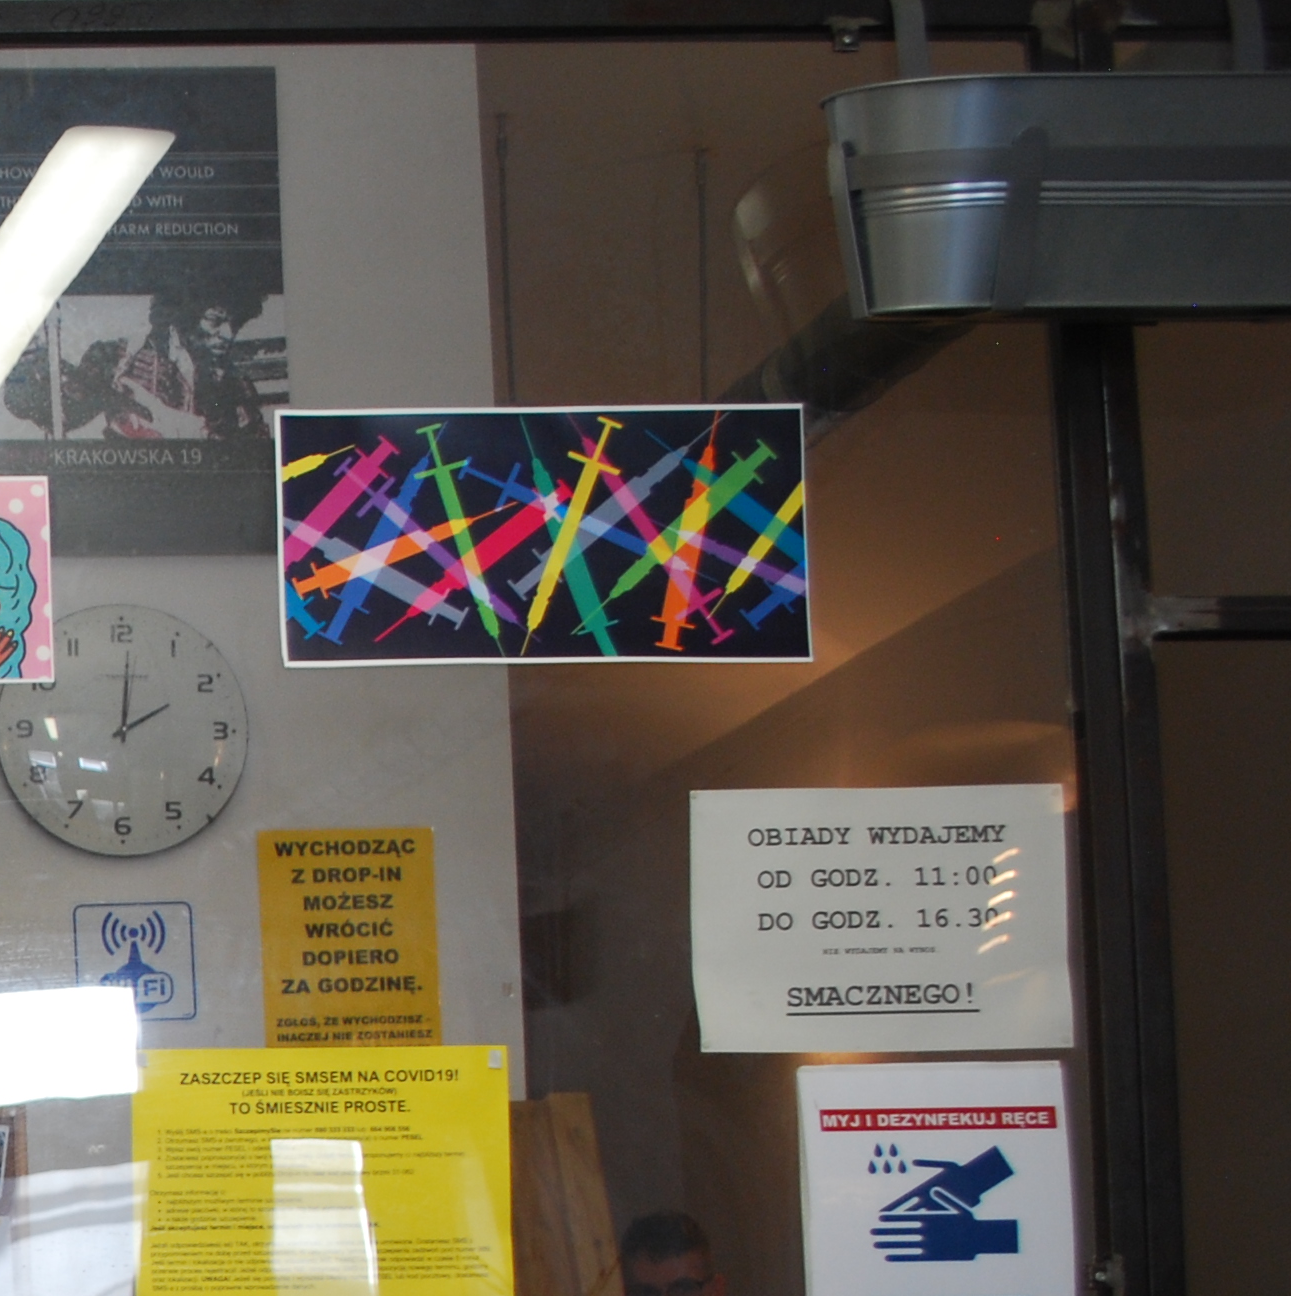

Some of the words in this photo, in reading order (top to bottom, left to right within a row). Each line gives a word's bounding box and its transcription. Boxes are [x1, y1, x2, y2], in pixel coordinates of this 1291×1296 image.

[159, 165, 214, 179] WOULD
[146, 195, 183, 208] WITH
[156, 222, 239, 235] REDUCTION
[54, 447, 174, 465] KRAKOWSKA
[180, 447, 202, 465] 19
[110, 624, 133, 643] 12
[197, 673, 214, 693] 2
[16, 719, 34, 739] 9
[212, 721, 229, 741] 3
[197, 766, 216, 785] 4
[66, 800, 84, 819] 7
[165, 801, 183, 820] 5
[114, 816, 132, 836] 6
[747, 826, 851, 847] OBIADY
[867, 824, 1007, 845] WYDAJEMY
[274, 838, 416, 858] WYCHODZĄC
[290, 869, 306, 884] Z
[312, 867, 402, 884] DROP-IN
[756, 869, 792, 889] OD
[810, 869, 893, 889] GODZ.
[914, 865, 998, 887] 11:00
[303, 890, 393, 912] MOŻESZ
[305, 917, 394, 939] WRÓCIĆ
[756, 911, 794, 931] DO
[812, 910, 895, 930] GODZ.
[917, 907, 999, 929] 16.30
[301, 948, 400, 967] DOPIERO
[281, 979, 311, 995] ZA
[318, 975, 424, 995] GODZINĘ.
[786, 983, 975, 1008] SMACZNEGO!
[342, 1014, 423, 1025] WYCHODZISZ
[277, 1031, 329, 1042] INACZEJ
[333, 1030, 353, 1041] NIE
[356, 1028, 433, 1040] ZOSTANIESZ
[179, 1071, 262, 1086] ZASZCZEP
[268, 1071, 291, 1087] SIĘ
[295, 1070, 353, 1085] SMSEM
[357, 1070, 381, 1084] NA
[384, 1068, 459, 1083] COVID19!
[229, 1101, 252, 1116] TO
[255, 1099, 340, 1115] ŚMIESZNIE
[344, 1099, 412, 1114] PROSTE.
[823, 1113, 861, 1129] MYJ
[865, 1113, 872, 1128] I
[877, 1111, 997, 1127] DEZYNFEKUJ
[1001, 1111, 1050, 1129] RĘCE
